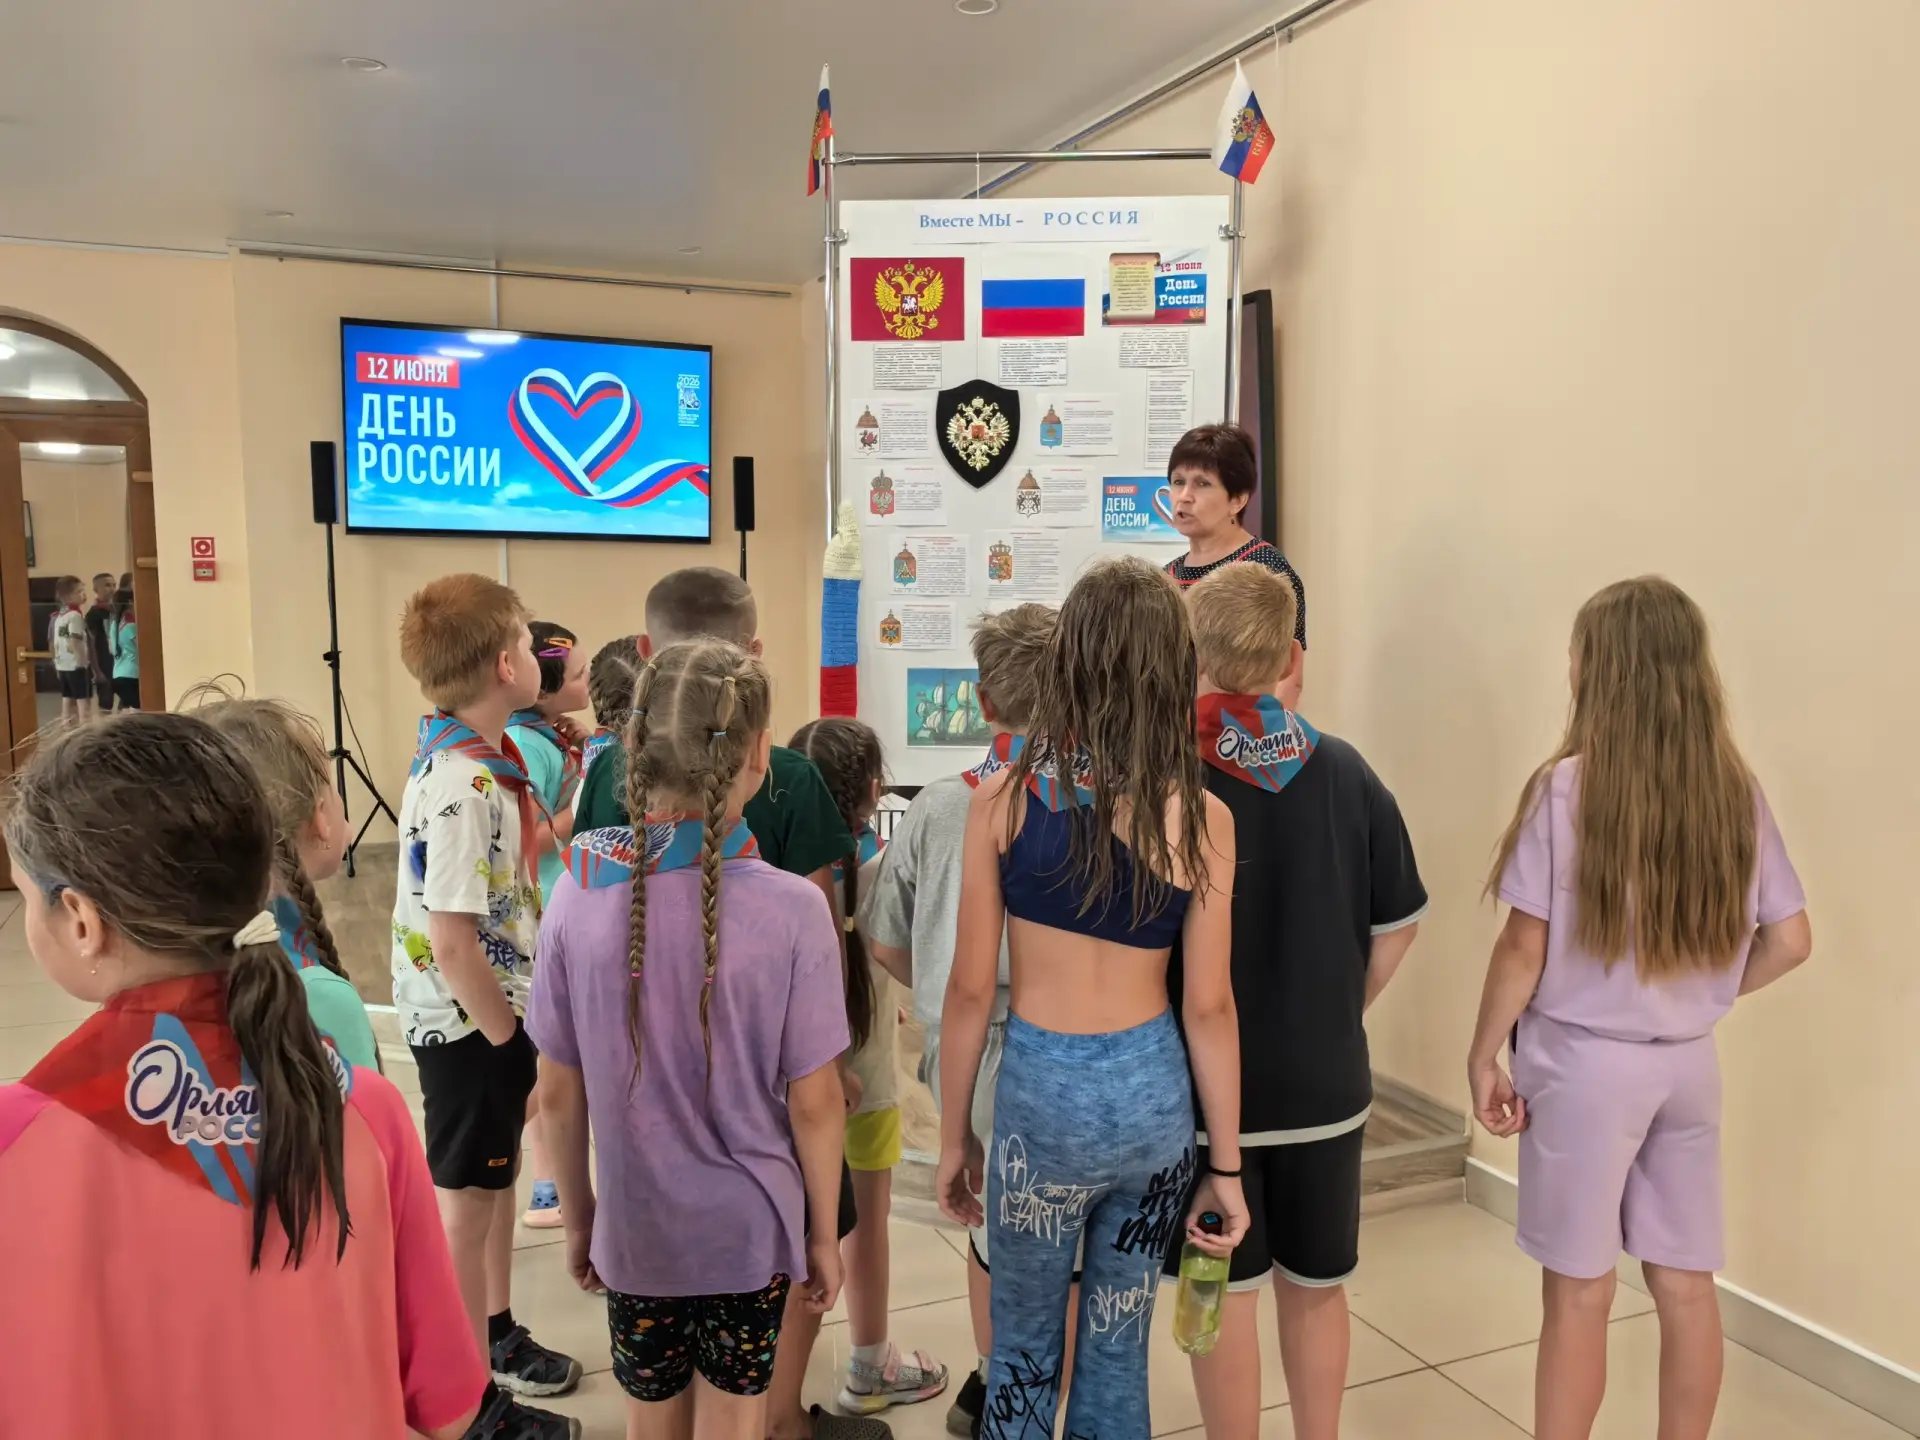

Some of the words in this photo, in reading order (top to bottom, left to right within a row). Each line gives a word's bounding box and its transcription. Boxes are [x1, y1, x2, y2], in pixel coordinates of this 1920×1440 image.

[920, 214, 974, 228] Вместе
[978, 213, 1011, 227] МЫ
[1044, 210, 1138, 225] РОССИЯ
[1160, 263, 1171, 272] 12
[1165, 278, 1198, 292] День
[1159, 294, 1205, 306] России
[367, 357, 388, 379] 12
[393, 358, 448, 383] ИЮНЯ
[357, 392, 456, 440] ДЕНЬ
[357, 441, 501, 487] РОССИИ
[1105, 497, 1136, 513] ДЕНЬ
[1105, 513, 1150, 527] РОССИИ
[1218, 728, 1293, 762] Орлята
[1239, 747, 1297, 766] РОССИИ
[130, 1044, 260, 1130] Орля
[177, 1115, 262, 1140] РОСС
